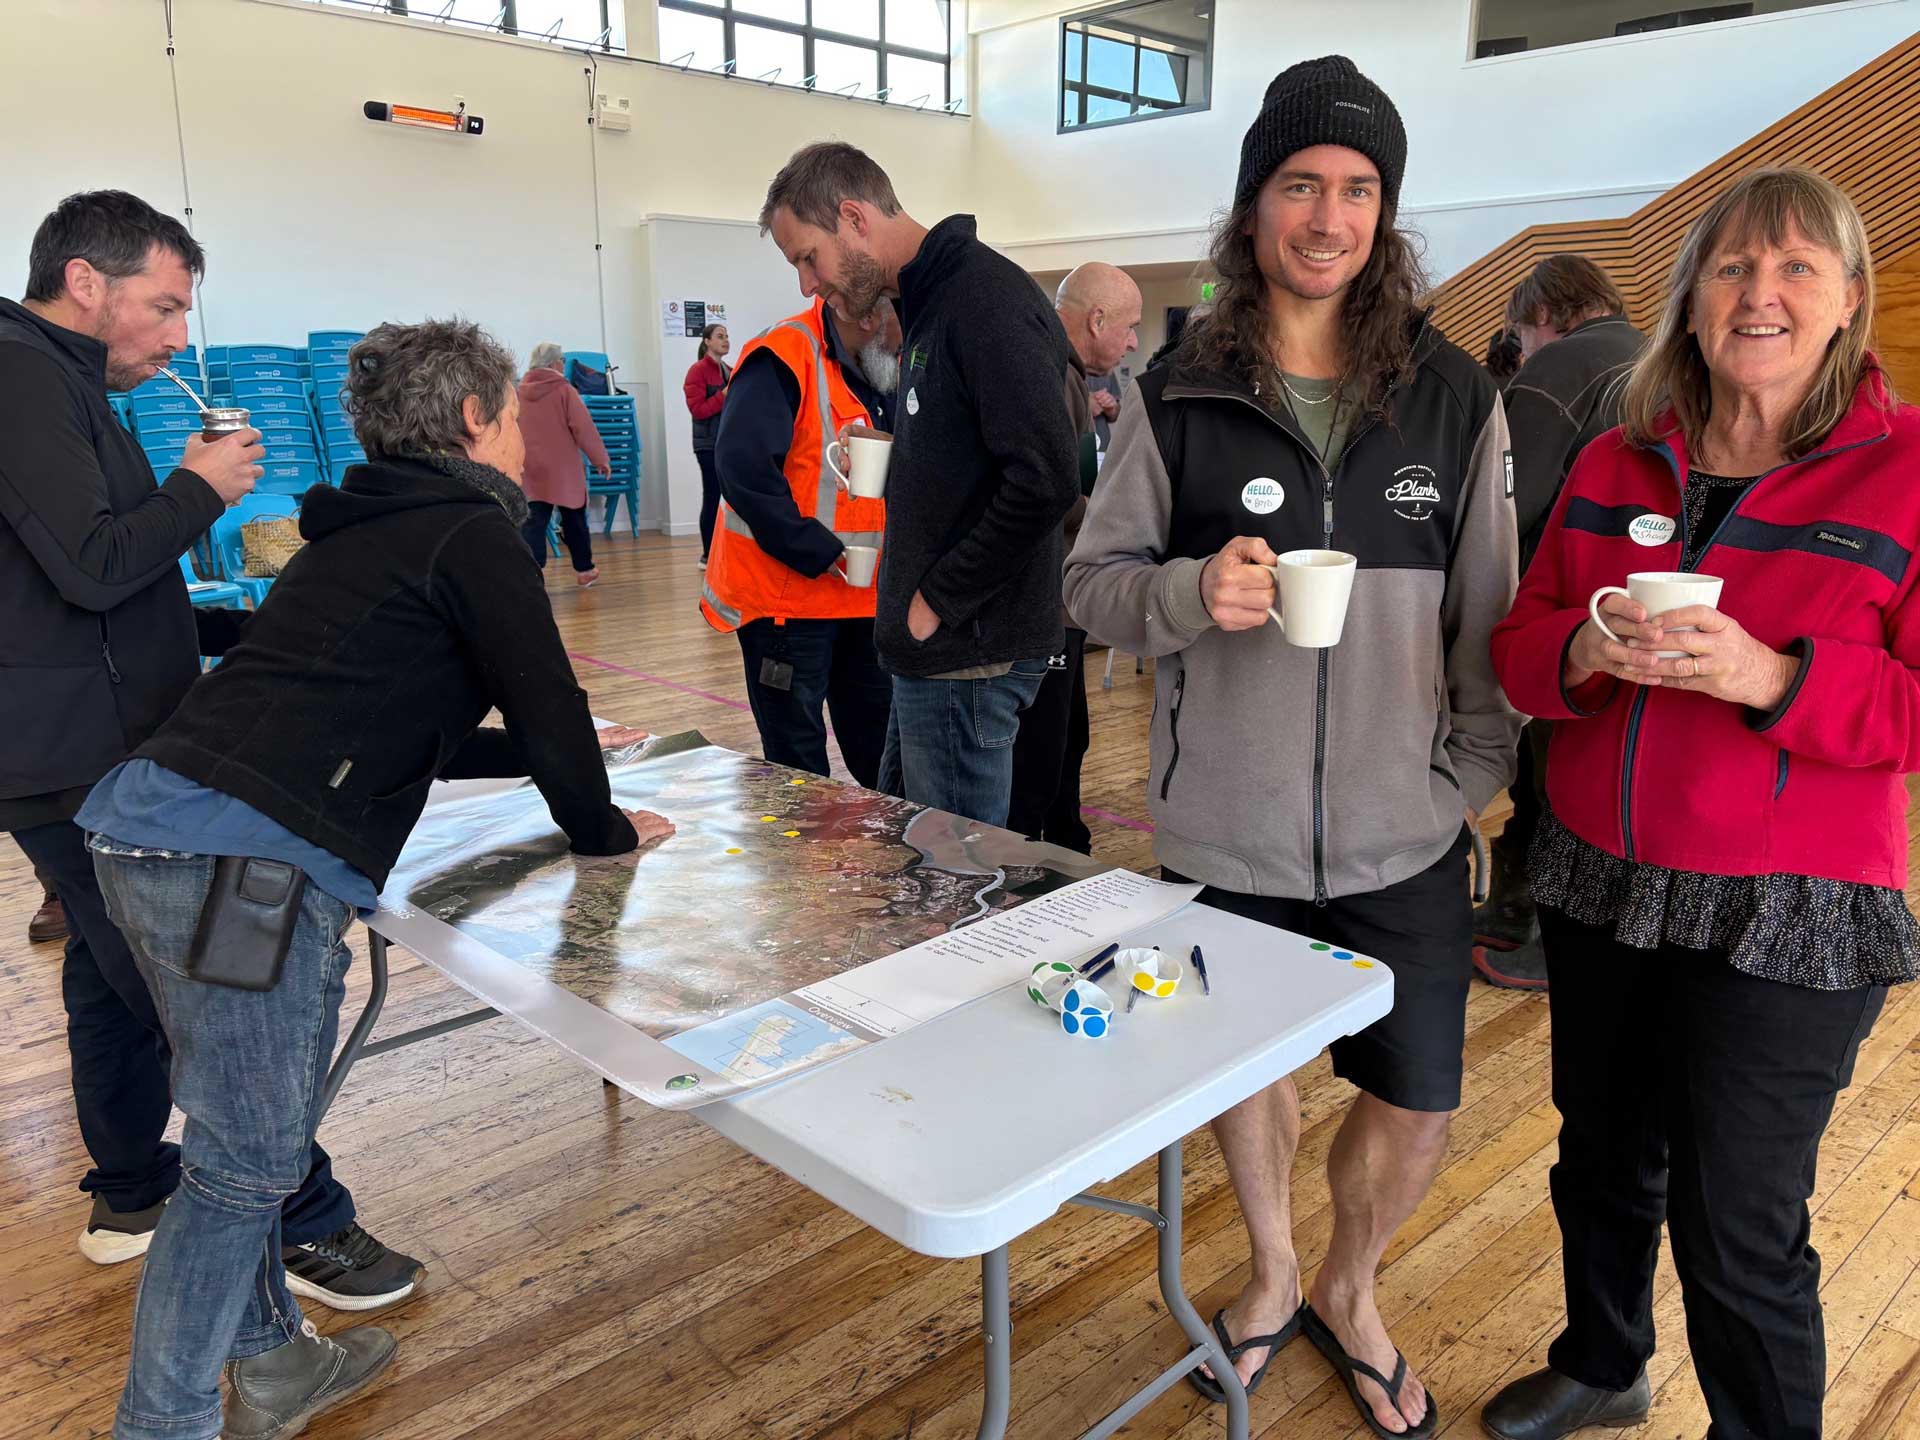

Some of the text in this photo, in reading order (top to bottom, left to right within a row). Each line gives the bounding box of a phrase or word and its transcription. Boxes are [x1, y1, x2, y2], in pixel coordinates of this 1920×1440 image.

[1247, 484, 1280, 496] HELLO...
[1385, 479, 1441, 502] Planks
[1636, 518, 1673, 532] HELLO...
[808, 1006, 854, 1031] Overview
